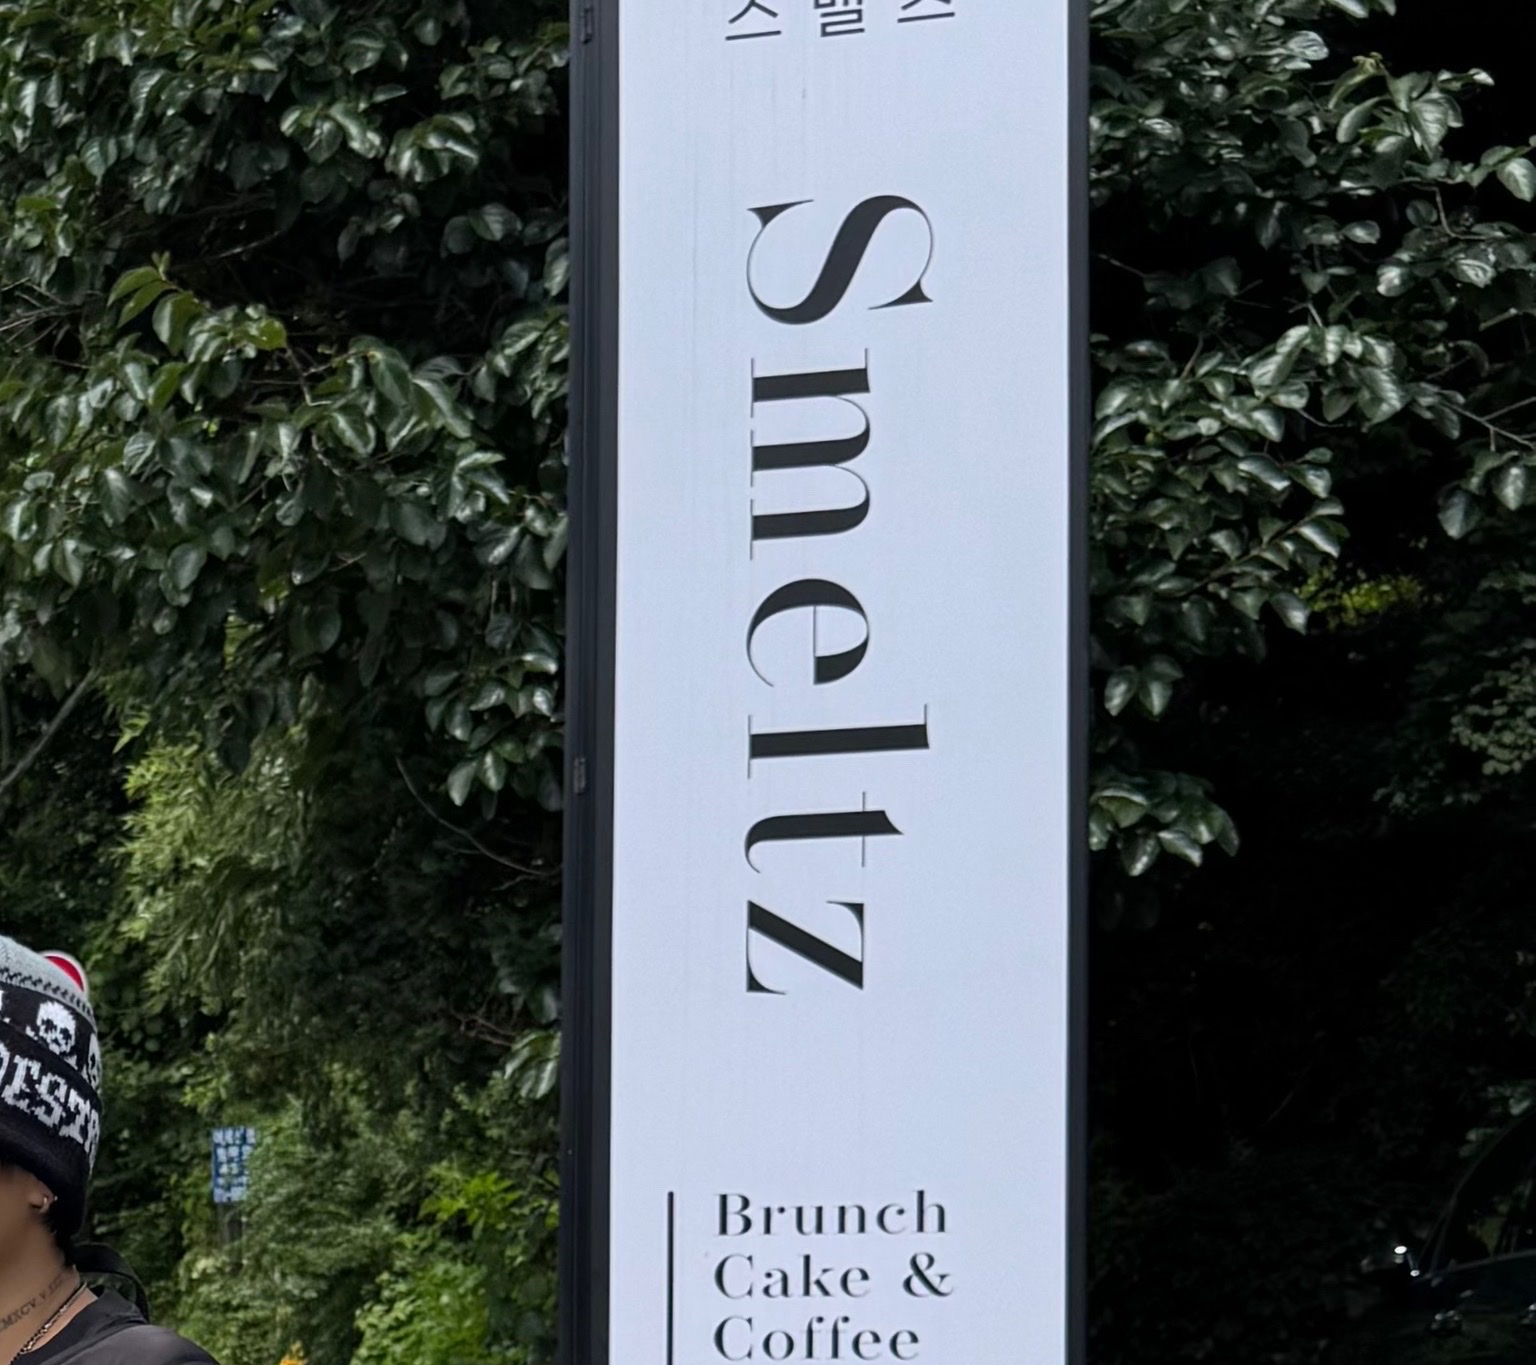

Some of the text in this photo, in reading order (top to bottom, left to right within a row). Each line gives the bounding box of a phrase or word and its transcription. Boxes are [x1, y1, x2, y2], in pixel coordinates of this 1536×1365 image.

[744, 195, 934, 996] Smeltz
[713, 1190, 947, 1236] Brunch
[713, 1252, 954, 1299] Cake &
[713, 1315, 920, 1361] Coffee
